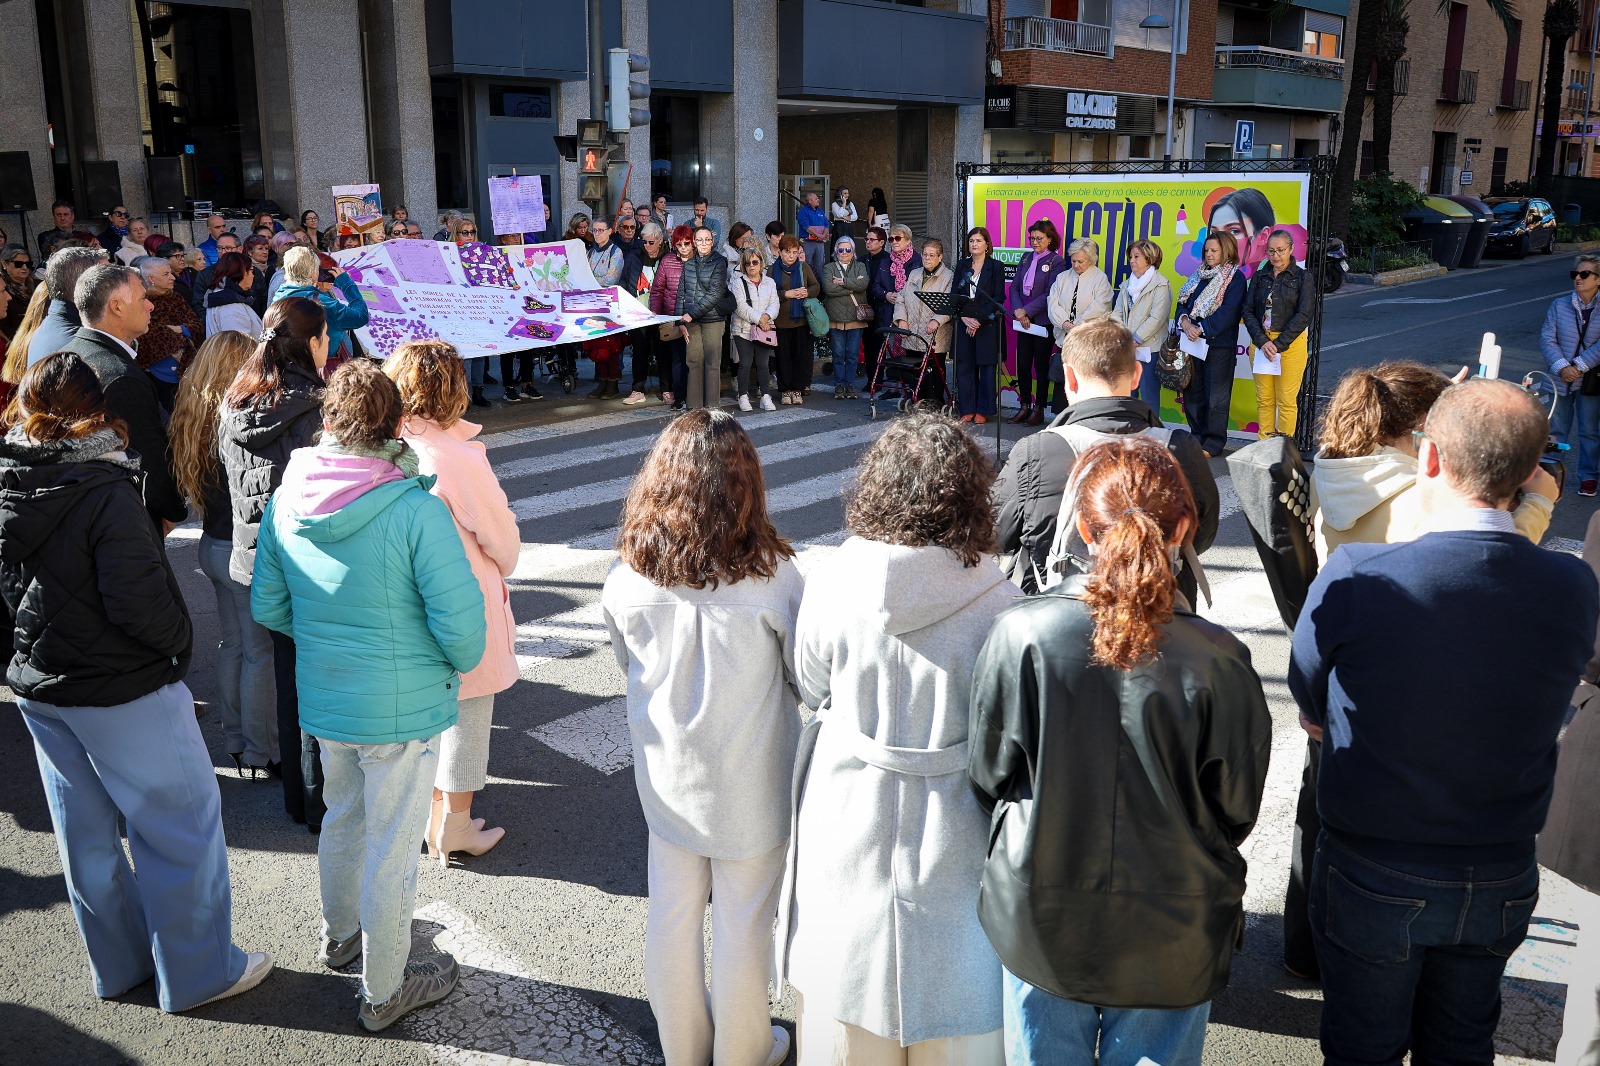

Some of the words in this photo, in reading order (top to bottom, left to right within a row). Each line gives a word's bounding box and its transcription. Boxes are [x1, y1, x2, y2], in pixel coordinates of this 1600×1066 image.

[1065, 116, 1116, 130] CALZADOS
[1239, 124, 1250, 150] P
[986, 188, 1013, 196] Encara
[1015, 190, 1029, 198] que
[1031, 188, 1038, 196] el
[1061, 188, 1090, 196] semble
[1093, 188, 1110, 198] llarg
[1126, 188, 1154, 197] deixes
[1157, 188, 1168, 196] de
[1171, 188, 1209, 197] caminar
[992, 252, 1023, 263] NOVE
